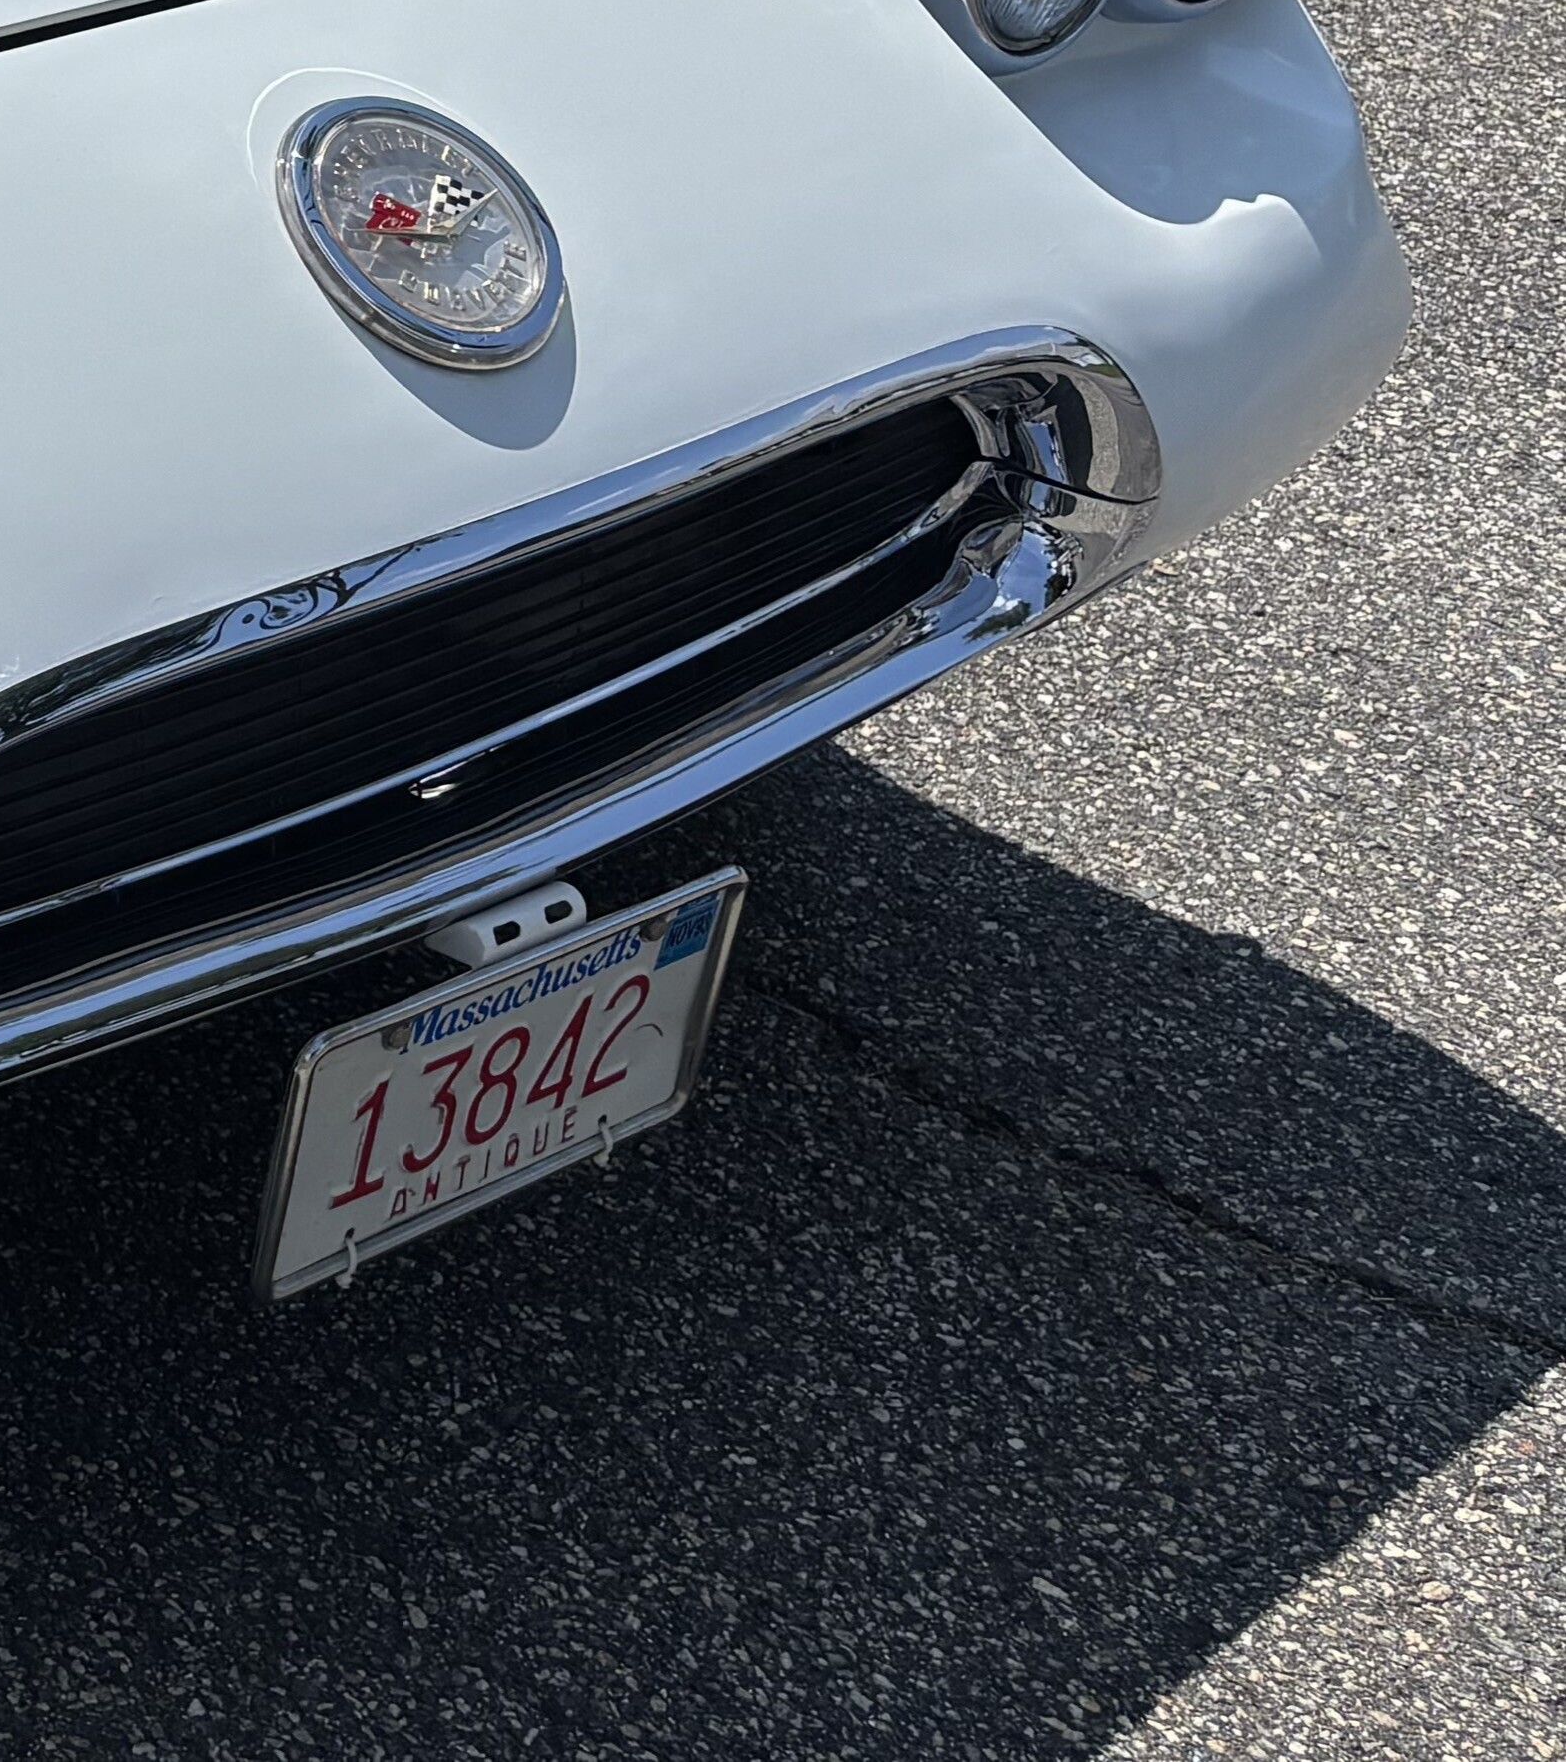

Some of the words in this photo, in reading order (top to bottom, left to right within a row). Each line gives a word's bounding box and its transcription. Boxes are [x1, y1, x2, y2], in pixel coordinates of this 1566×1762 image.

[399, 925, 642, 1055] Massachusetts
[328, 974, 651, 1210] 13842
[388, 1105, 578, 1220] ANTIQUE
